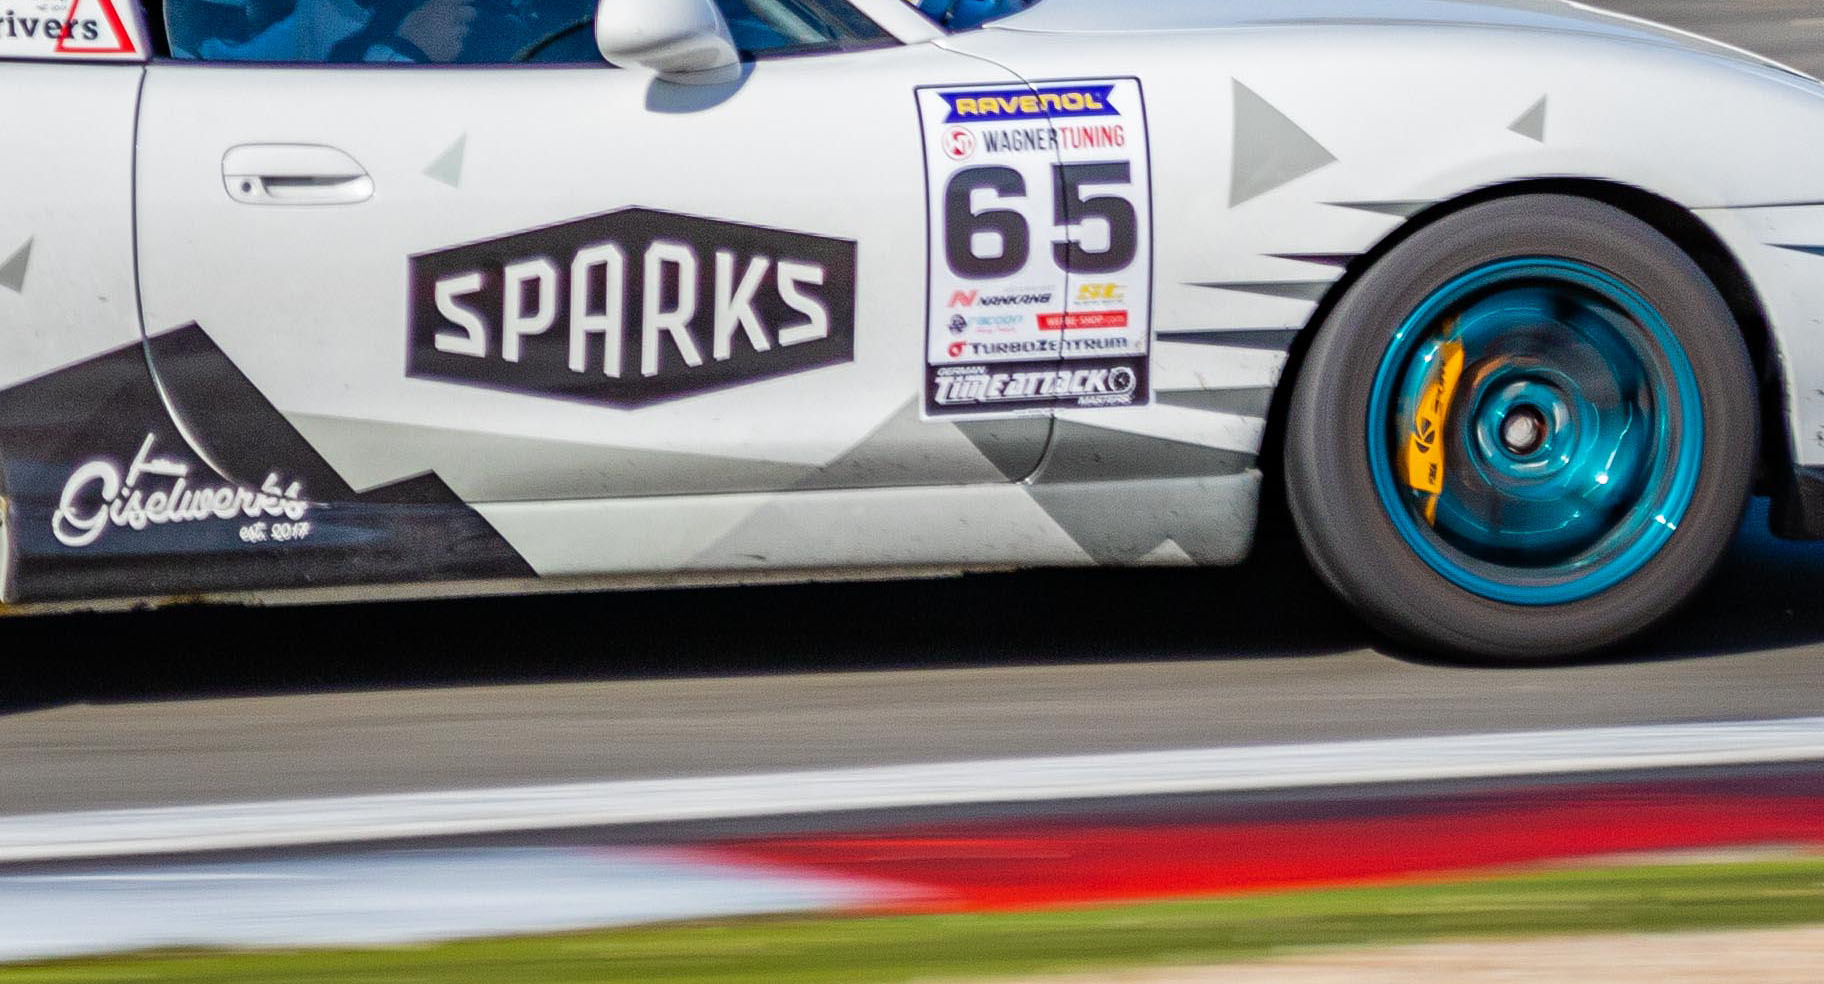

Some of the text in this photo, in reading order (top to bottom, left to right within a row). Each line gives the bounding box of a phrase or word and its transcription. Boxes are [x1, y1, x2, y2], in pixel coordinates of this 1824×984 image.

[956, 93, 1103, 115] RAVENOL
[945, 160, 1137, 280] 65
[435, 241, 828, 377] SPARKS
[969, 337, 1127, 355] TURBOZENTRUM
[52, 460, 309, 547] Giselwerks
